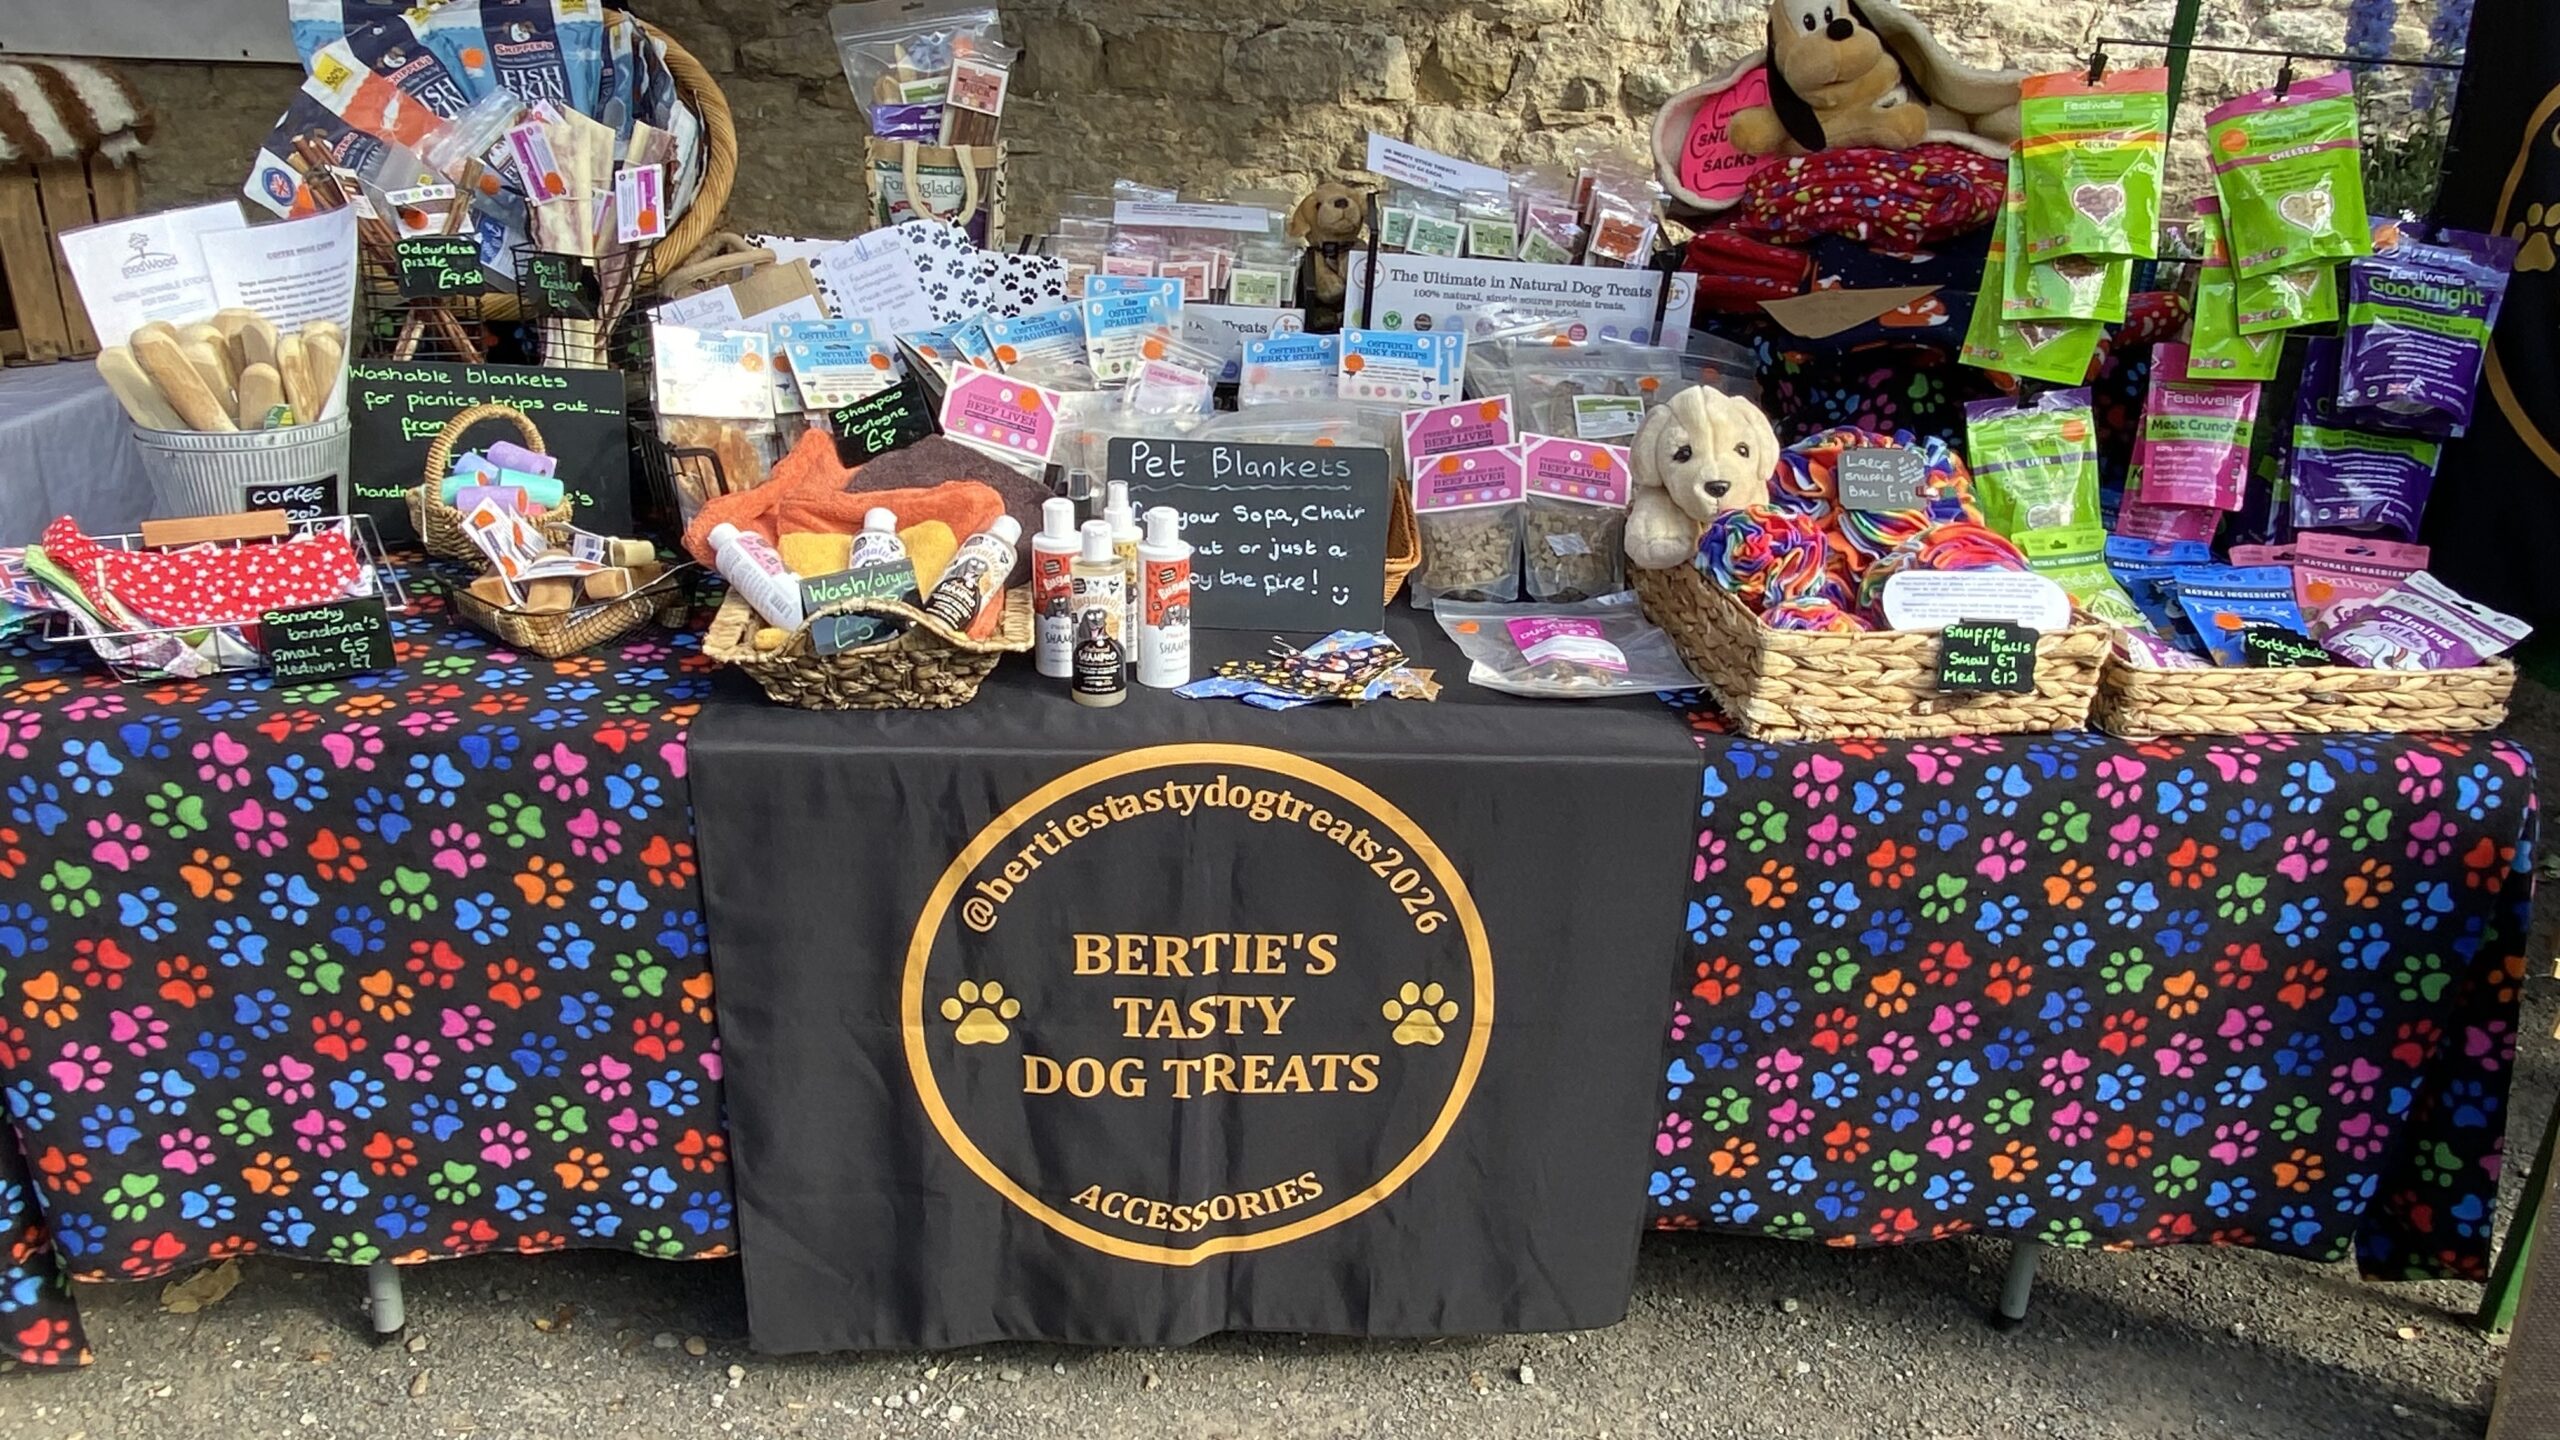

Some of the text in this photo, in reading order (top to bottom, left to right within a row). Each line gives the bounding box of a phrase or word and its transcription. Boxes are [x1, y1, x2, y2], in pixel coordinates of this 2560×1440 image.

[501, 66, 561, 87] FISH
[506, 82, 565, 101] SKIN
[962, 83, 991, 97] DUCK
[1702, 153, 1758, 173] SACKS
[2268, 146, 2311, 162] CHEESY
[397, 242, 477, 256] Odourless
[532, 261, 567, 276] Beef
[2388, 266, 2465, 286] Feelwells
[1390, 268, 1653, 299] The Ultimate in Natural Dog Treats
[2368, 276, 2487, 310] Goodnight
[1413, 288, 1440, 299] 100%
[1519, 296, 1553, 307] source
[1554, 298, 1592, 310] protein
[1456, 301, 1472, 311] the
[1108, 306, 1148, 320] OSTRICH
[799, 330, 848, 341] OSTRICH
[1013, 319, 1059, 336] OSTRICH
[815, 350, 864, 359] OSTRICH
[1268, 345, 1316, 354] OSTRICH
[1352, 347, 1428, 360] JERKY STRIPS
[1367, 340, 1413, 351] OSTRICH
[1254, 351, 1330, 363] JERKY STRIPS
[349, 364, 568, 388] Washable blankets
[363, 391, 589, 414] for picnics trips out
[835, 390, 903, 423] Shampoo
[2163, 390, 2242, 408] Feelwells
[966, 400, 999, 415] BEEF
[1000, 408, 1038, 427] LIVER
[401, 417, 448, 440] from
[2151, 419, 2185, 431] Meat
[866, 428, 897, 453] £8
[1424, 430, 1493, 448] BEEF LIVER
[1130, 440, 1352, 480] Pet Blankets
[2025, 456, 2052, 468] LIVER
[1434, 470, 1505, 488] BEEF LIVER
[1539, 463, 1612, 481] BEEF LIVER
[252, 486, 325, 504] COFFEE
[287, 505, 322, 519] OOD
[1177, 504, 1366, 531] your Sofa, Chair
[1238, 543, 1262, 555] or
[1268, 537, 1318, 562] just
[1328, 544, 1348, 558] a
[2303, 558, 2413, 578] NATURAL INGREDIENT
[1219, 568, 1320, 596] the fire!
[2184, 588, 2288, 599] NATURAL INGREDIENTS
[263, 607, 345, 625] Scrunchy
[287, 616, 381, 641] bandana's
[834, 616, 874, 649] £5
[1519, 622, 1558, 639] DUCK
[1944, 625, 2007, 646] Snuffle
[2380, 609, 2458, 651] calming
[339, 636, 371, 656] £5
[1990, 640, 2032, 655] balls
[275, 654, 372, 677] Medium £7
[1078, 651, 1118, 662] SHAMPOO
[1948, 651, 2017, 668] Small £7
[1942, 670, 1983, 684] Med.
[962, 775, 1449, 935] @bertiestastydogtreats2026
[1072, 932, 1338, 977] BERTIE'S
[1112, 995, 1296, 1039] TASTY
[1022, 1053, 1381, 1099] DOG TREATS
[1070, 1171, 1326, 1233] ACCESSORIES
